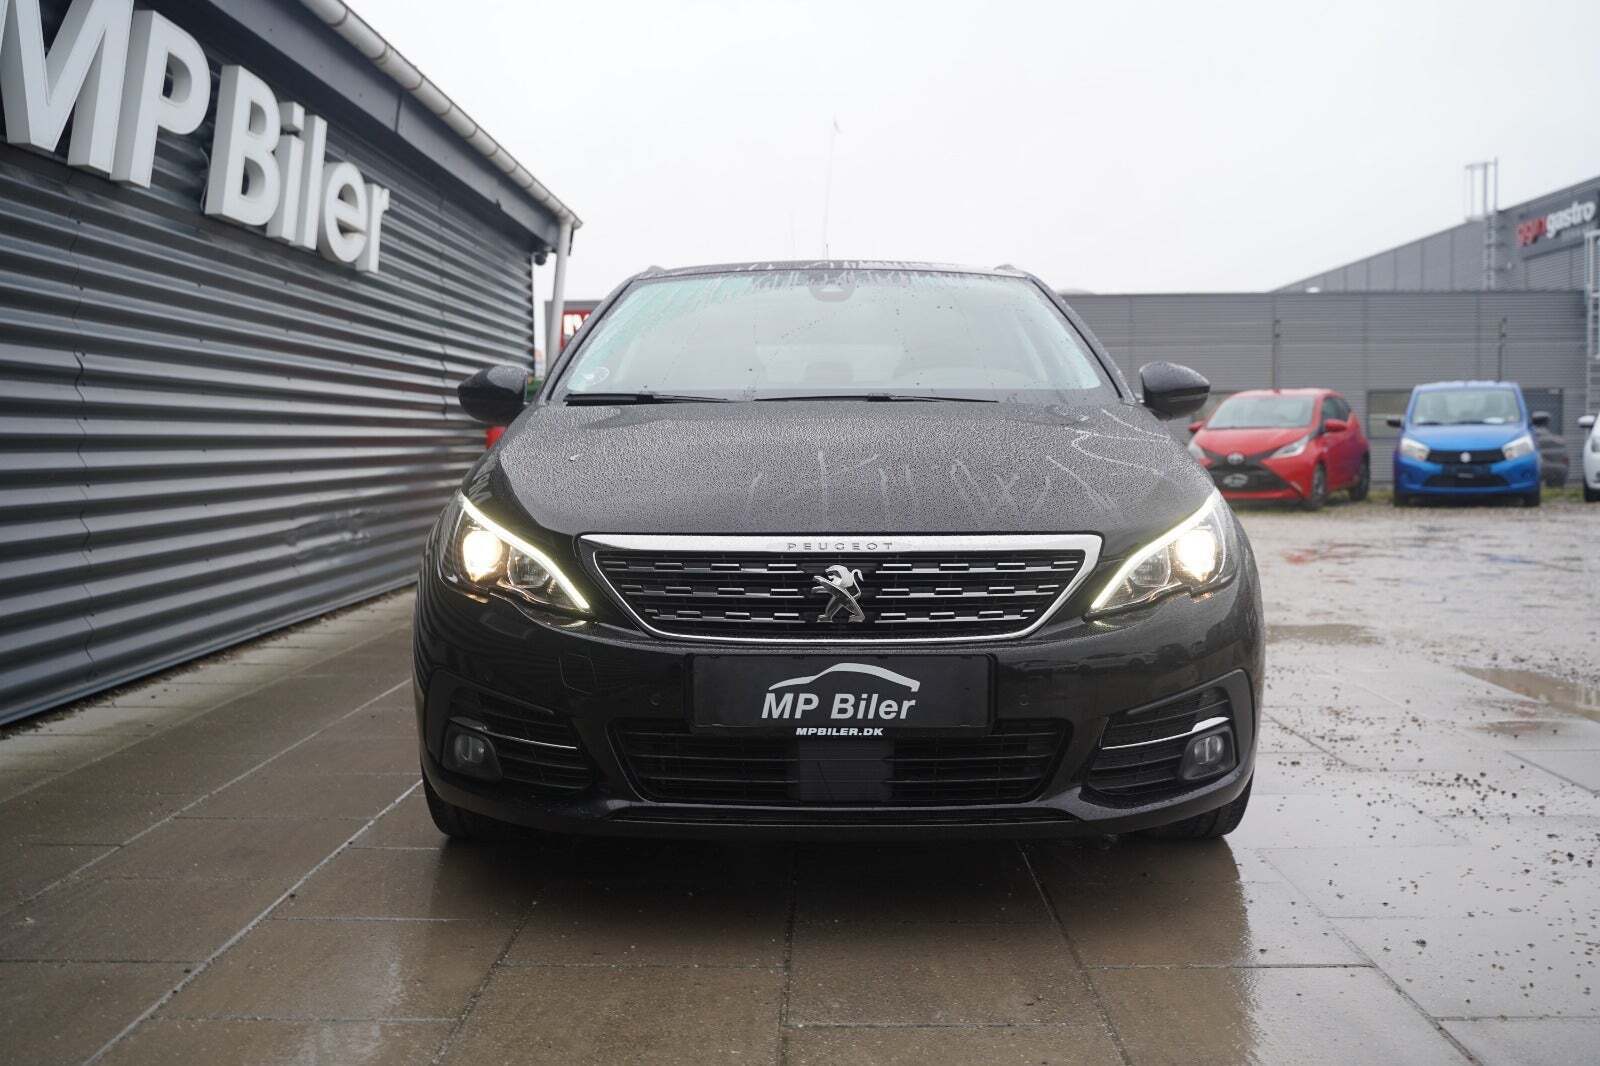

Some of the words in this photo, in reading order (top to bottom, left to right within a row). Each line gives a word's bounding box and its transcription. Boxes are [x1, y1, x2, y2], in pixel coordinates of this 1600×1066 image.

[0, 0, 210, 188] MP
[204, 64, 390, 274] Biler
[786, 542, 893, 551] PEUGEOT
[761, 693, 819, 719] MP
[830, 693, 916, 720] Biler
[795, 727, 884, 736] MPBILER.DK
